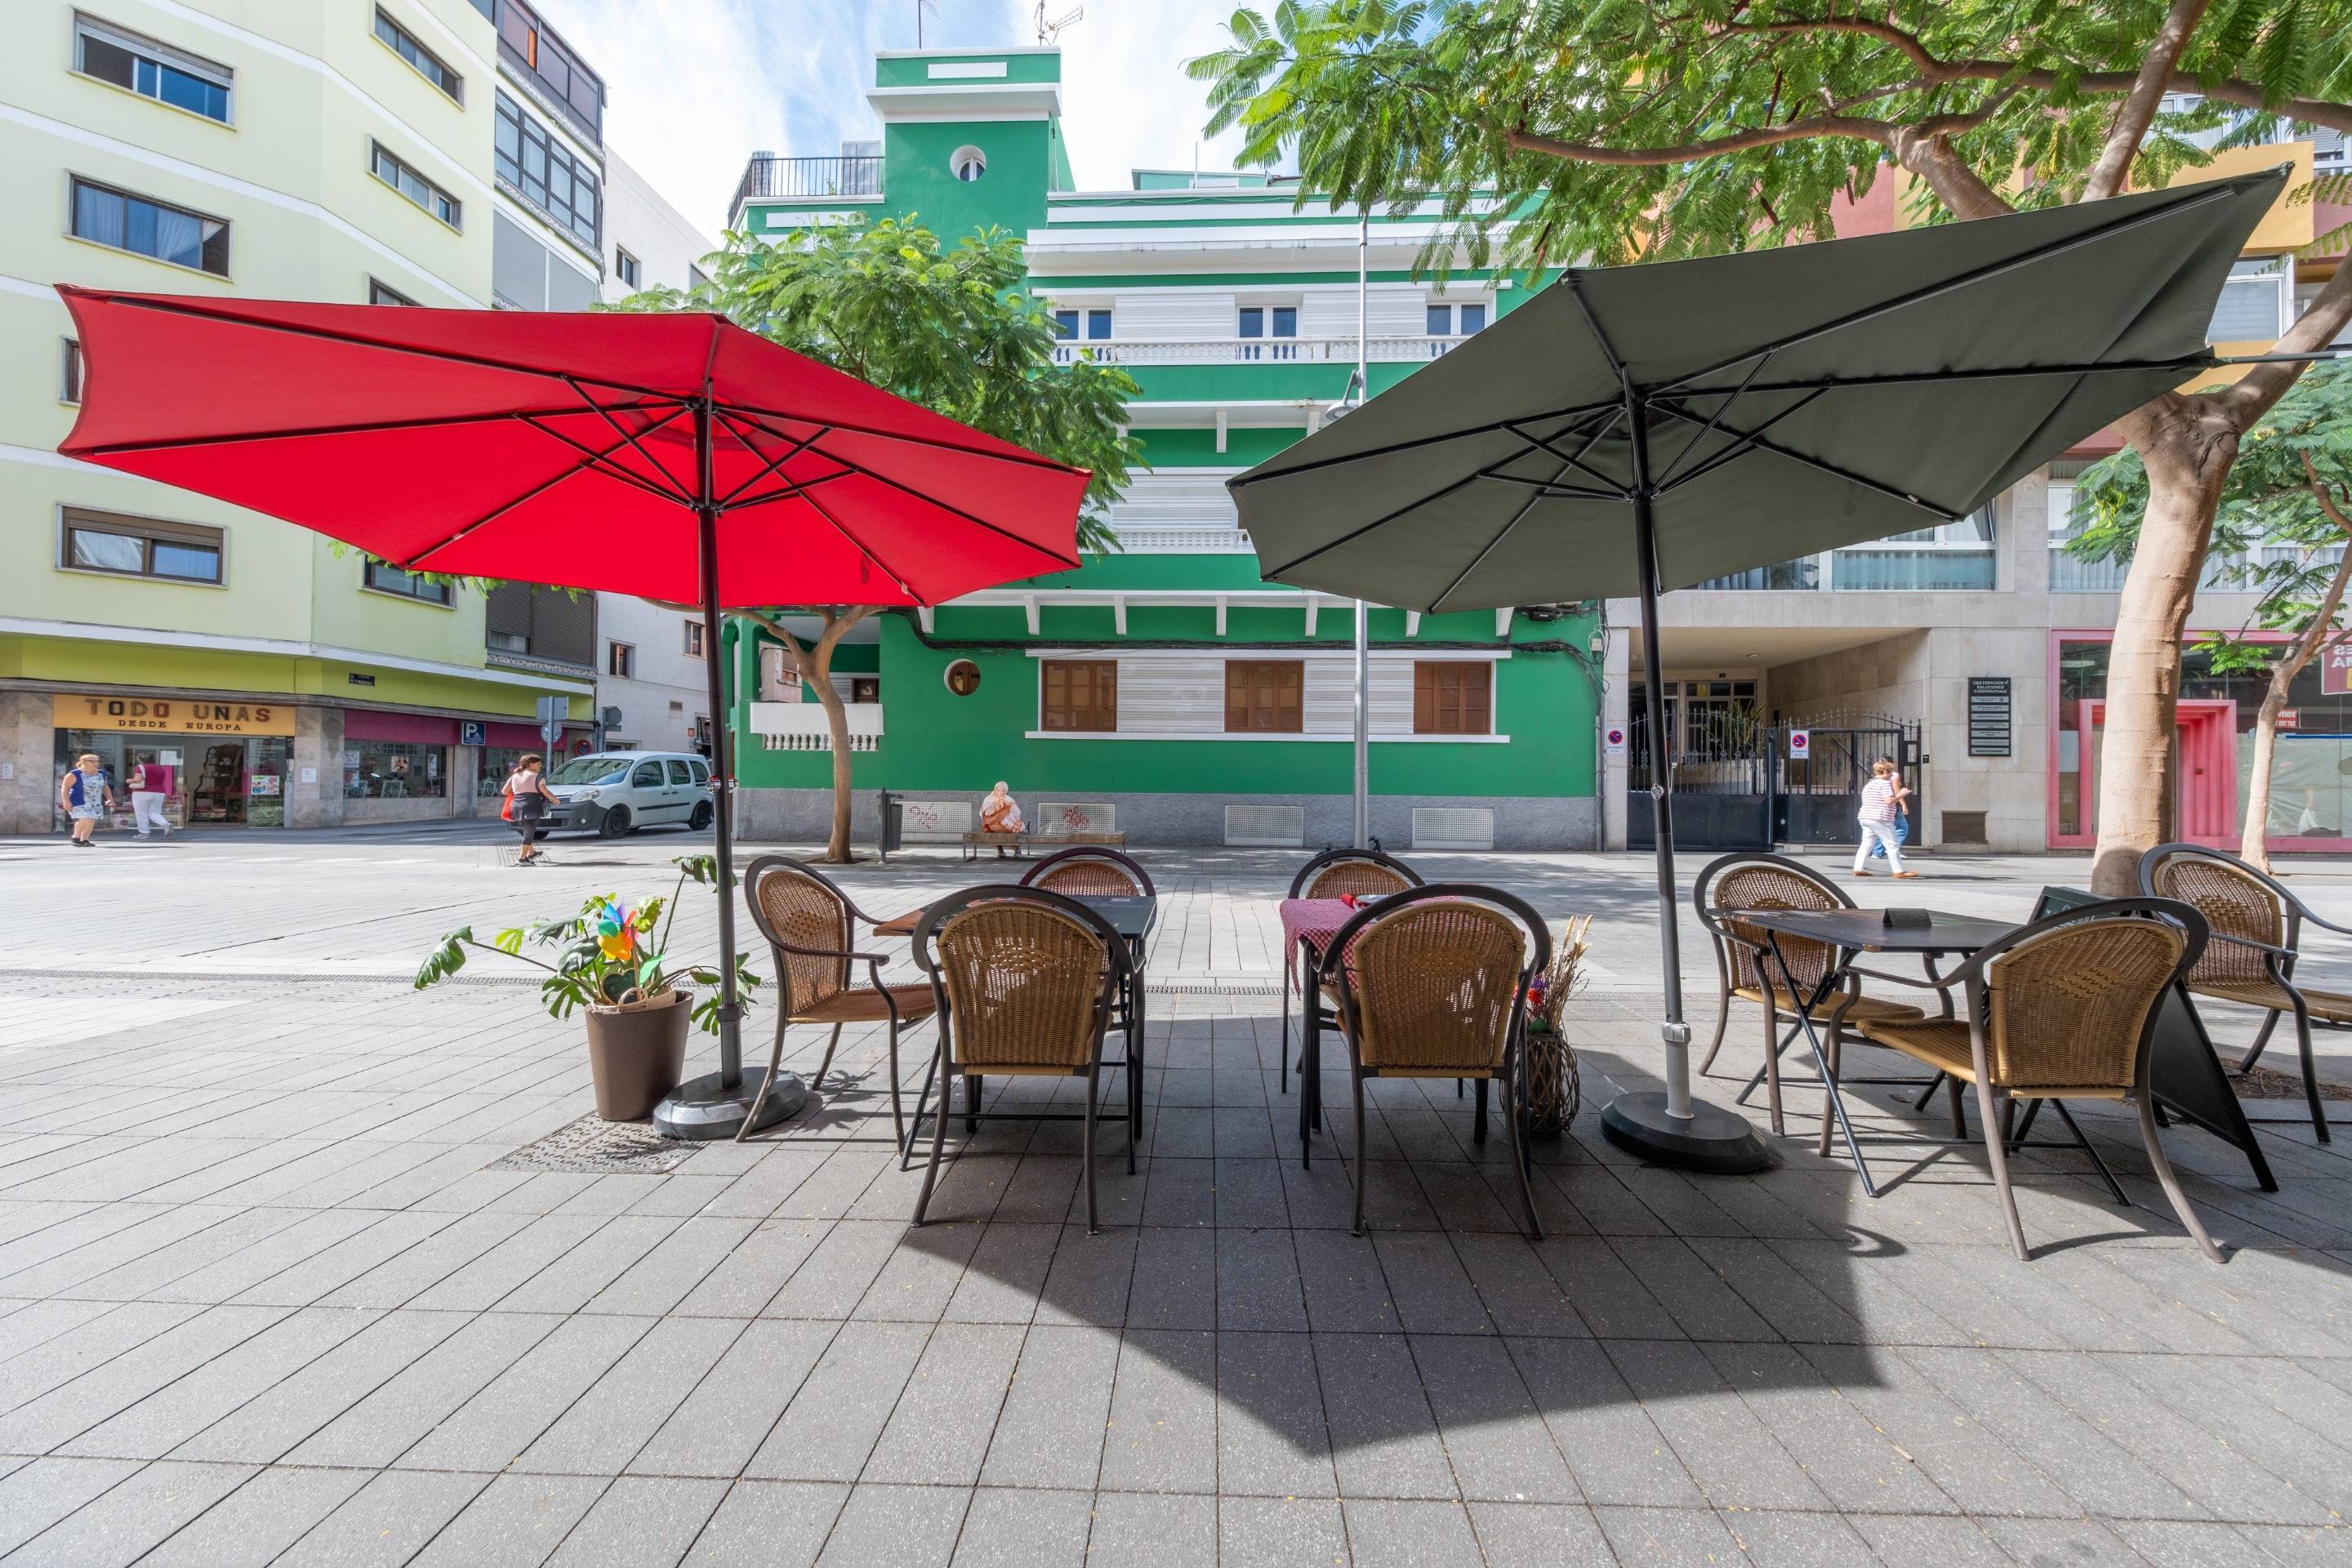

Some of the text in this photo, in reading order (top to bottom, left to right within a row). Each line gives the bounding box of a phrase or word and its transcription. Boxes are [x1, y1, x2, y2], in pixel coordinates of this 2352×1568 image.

[86, 699, 170, 718] TODO
[118, 719, 242, 732] DESDE EUROPA
[466, 724, 478, 737] P
